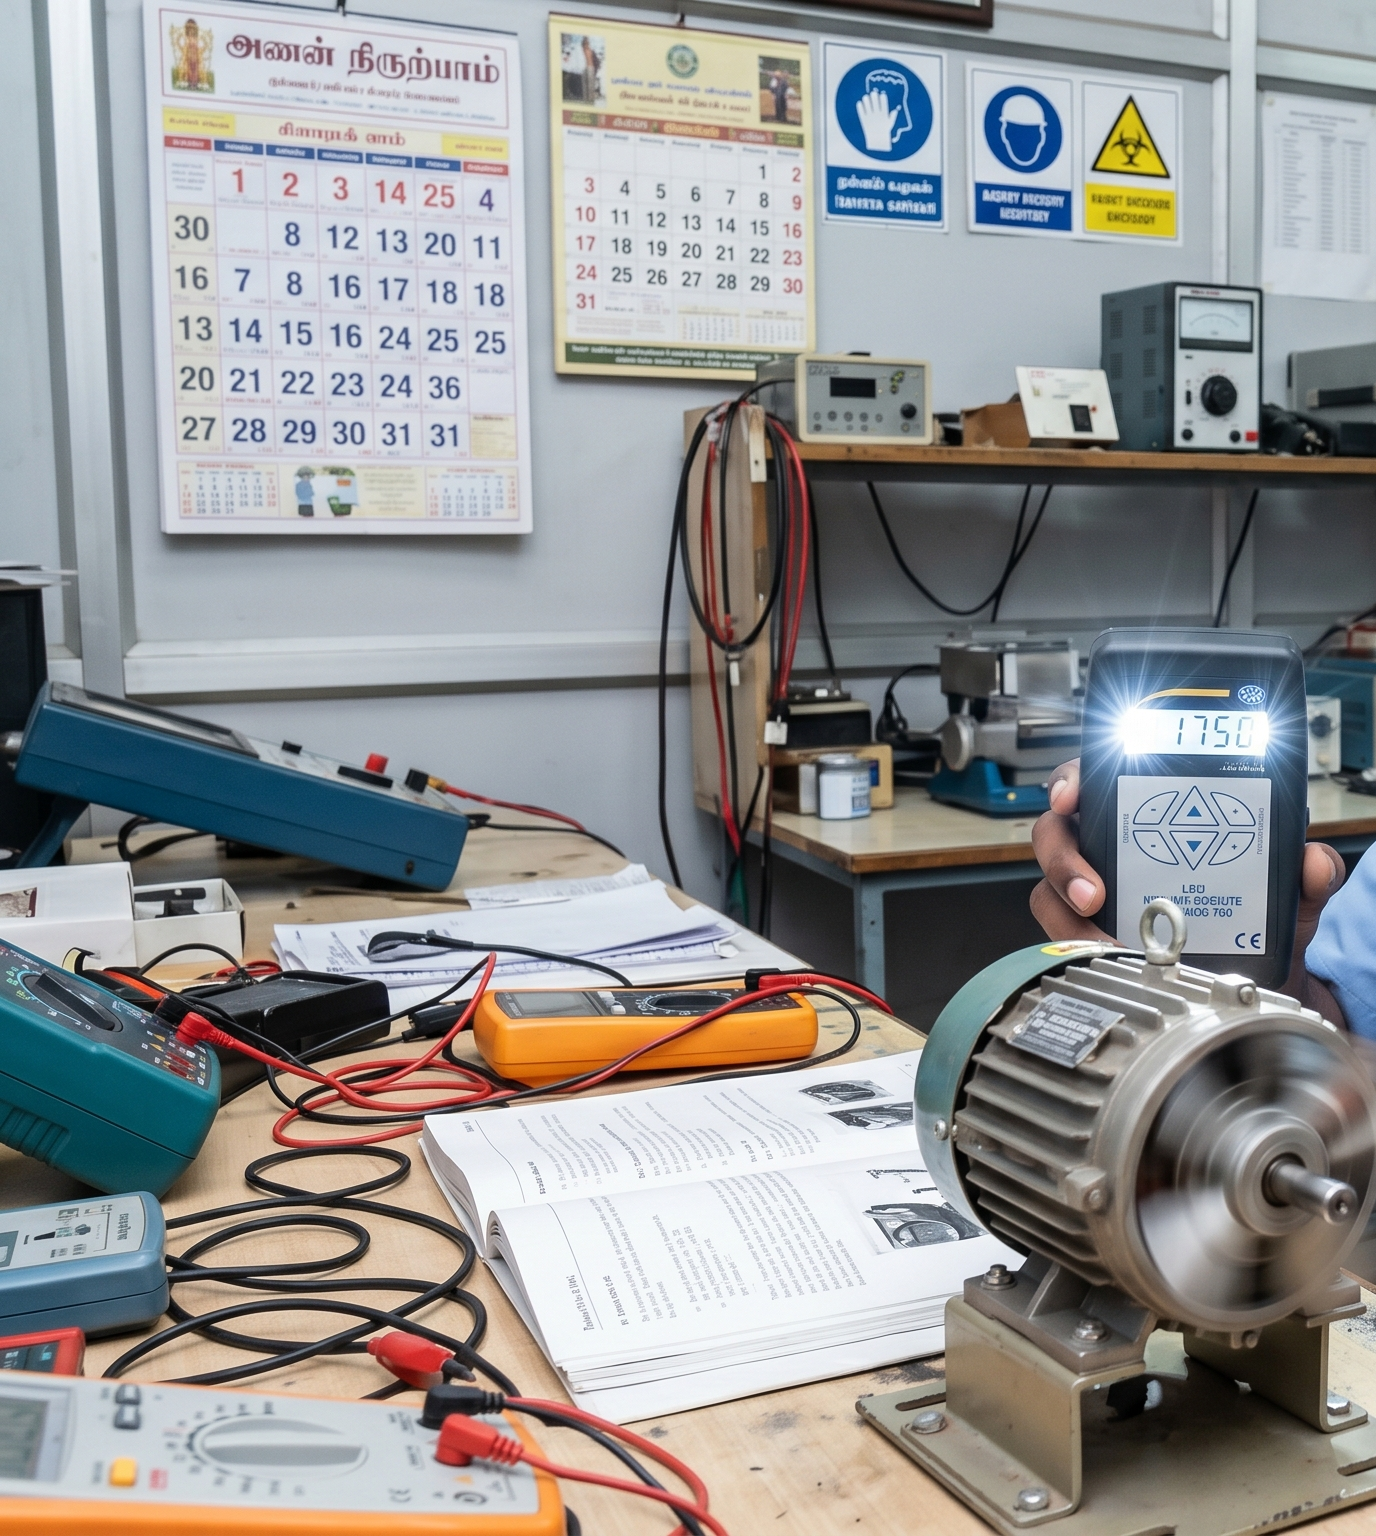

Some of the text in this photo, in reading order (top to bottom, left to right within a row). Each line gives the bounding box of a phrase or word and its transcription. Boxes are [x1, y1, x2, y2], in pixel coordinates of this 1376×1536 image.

[233, 169, 243, 193] 1
[283, 172, 298, 196] 2
[334, 177, 348, 200] 3
[376, 180, 406, 204] 14
[424, 184, 455, 208] 25
[479, 189, 494, 211] 4
[758, 164, 802, 183] 1 2
[584, 176, 803, 211] 3 4 5 6 7 8 9
[175, 215, 499, 259] 30 8 12 13 20 11
[575, 205, 803, 239] 10 11 12 13 14 15 16
[576, 235, 803, 267] 17 18 19 20 21 22 23
[176, 266, 504, 307] 16 7 8 16 17 18 18
[576, 263, 804, 295] 24 25 26 27 28 29 30
[576, 292, 595, 310] 31
[179, 316, 505, 354] 13 14 15 16 24 25 25
[181, 366, 460, 399] 20 21 22 23 24 36
[182, 417, 457, 447] 27 28 29 30 31 31
[1177, 716, 1254, 748] 1750
